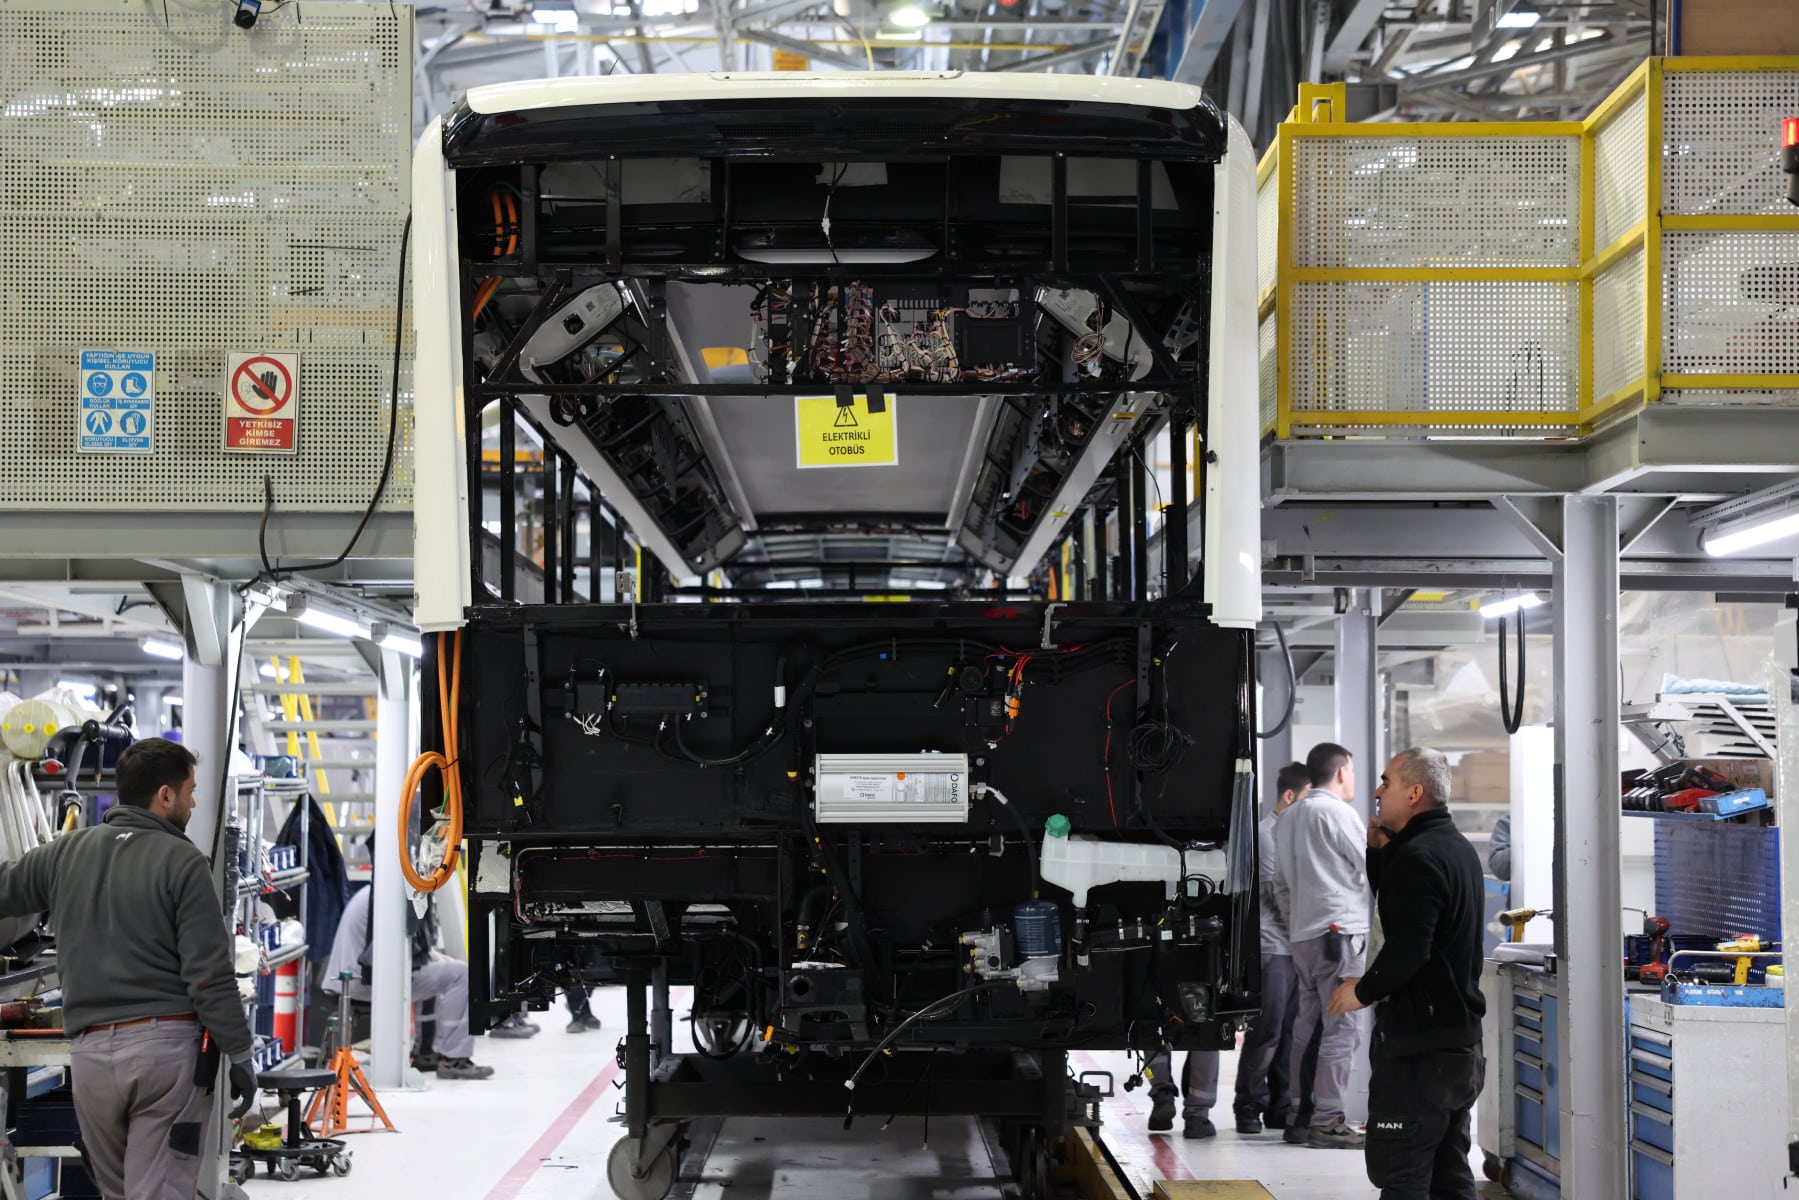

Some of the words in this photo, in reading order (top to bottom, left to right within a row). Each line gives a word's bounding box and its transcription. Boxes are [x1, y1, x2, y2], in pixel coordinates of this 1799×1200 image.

[239, 420, 282, 429] YETKİSİZ
[246, 429, 275, 437] KİMSE
[822, 429, 871, 441] ELEKTRİKLİ
[239, 438, 280, 446] GİREMEZ
[829, 444, 865, 455] OTOBÜS
[950, 783, 958, 803] DAFO
